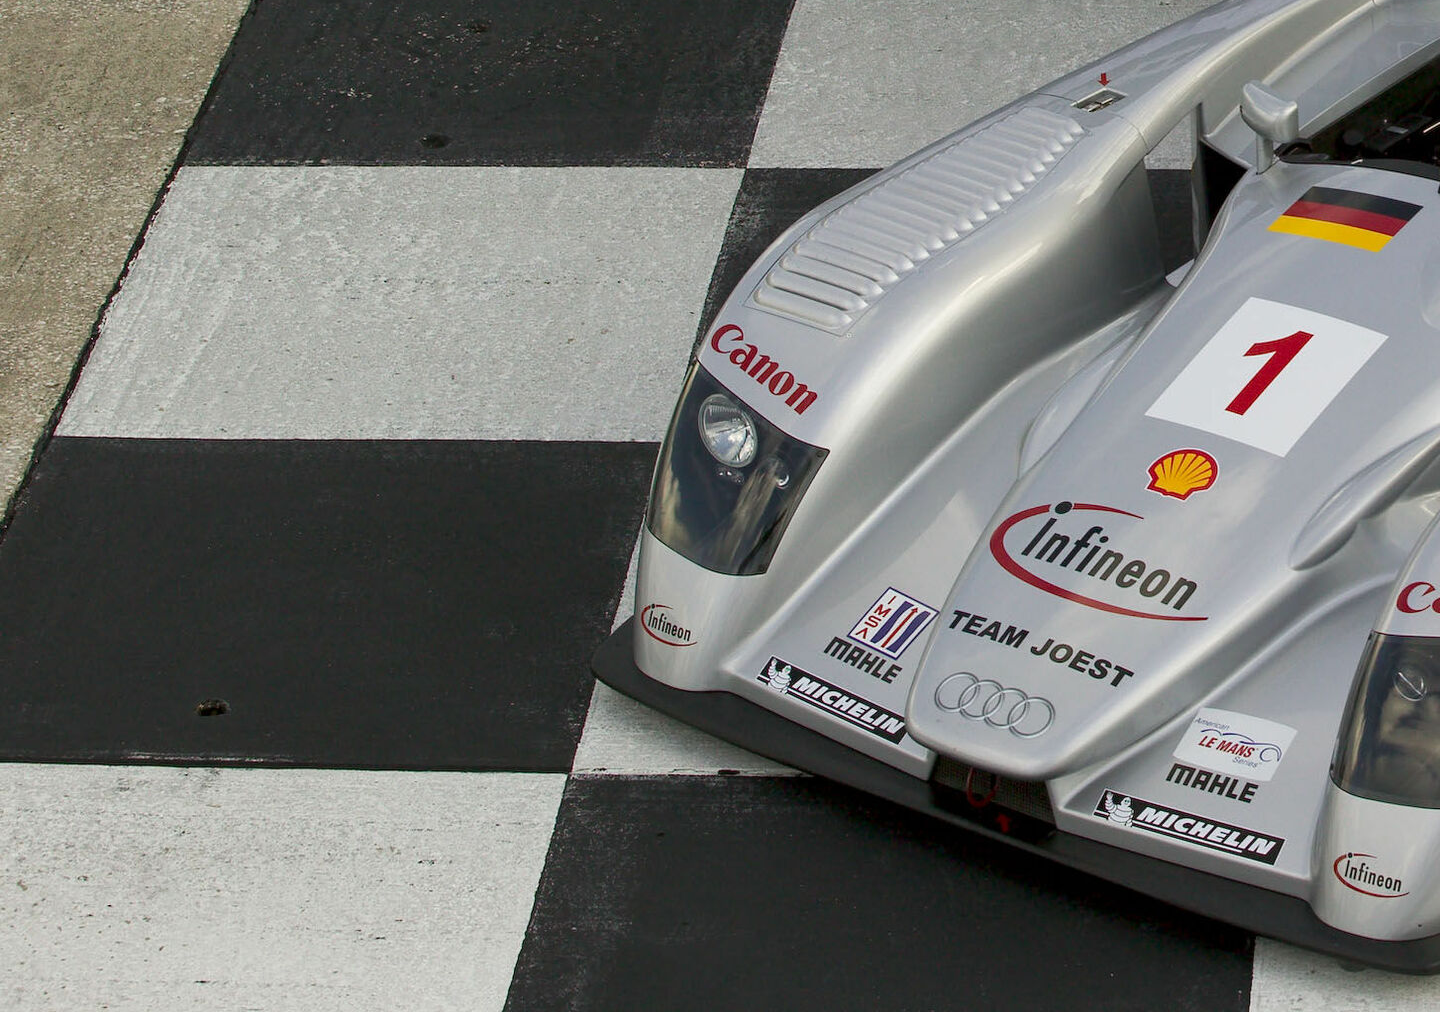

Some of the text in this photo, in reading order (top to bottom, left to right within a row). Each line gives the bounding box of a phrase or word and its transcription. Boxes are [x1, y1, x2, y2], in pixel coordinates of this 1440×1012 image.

[711, 323, 818, 416] Canon
[1225, 330, 1315, 416] 1
[1021, 502, 1198, 611] Infineon
[647, 603, 691, 642] Infineon
[854, 595, 897, 640] IMSA
[823, 636, 904, 685] MAHLE
[948, 609, 1135, 688] TEAM JOEST
[792, 675, 907, 735] MICHELIN
[1194, 716, 1231, 731] American
[1198, 734, 1256, 759] LE MANS
[1231, 755, 1259, 769] Series
[1165, 762, 1259, 804] MAHLE
[1136, 806, 1277, 856] MICHELIN
[1344, 852, 1402, 893] Infineon
